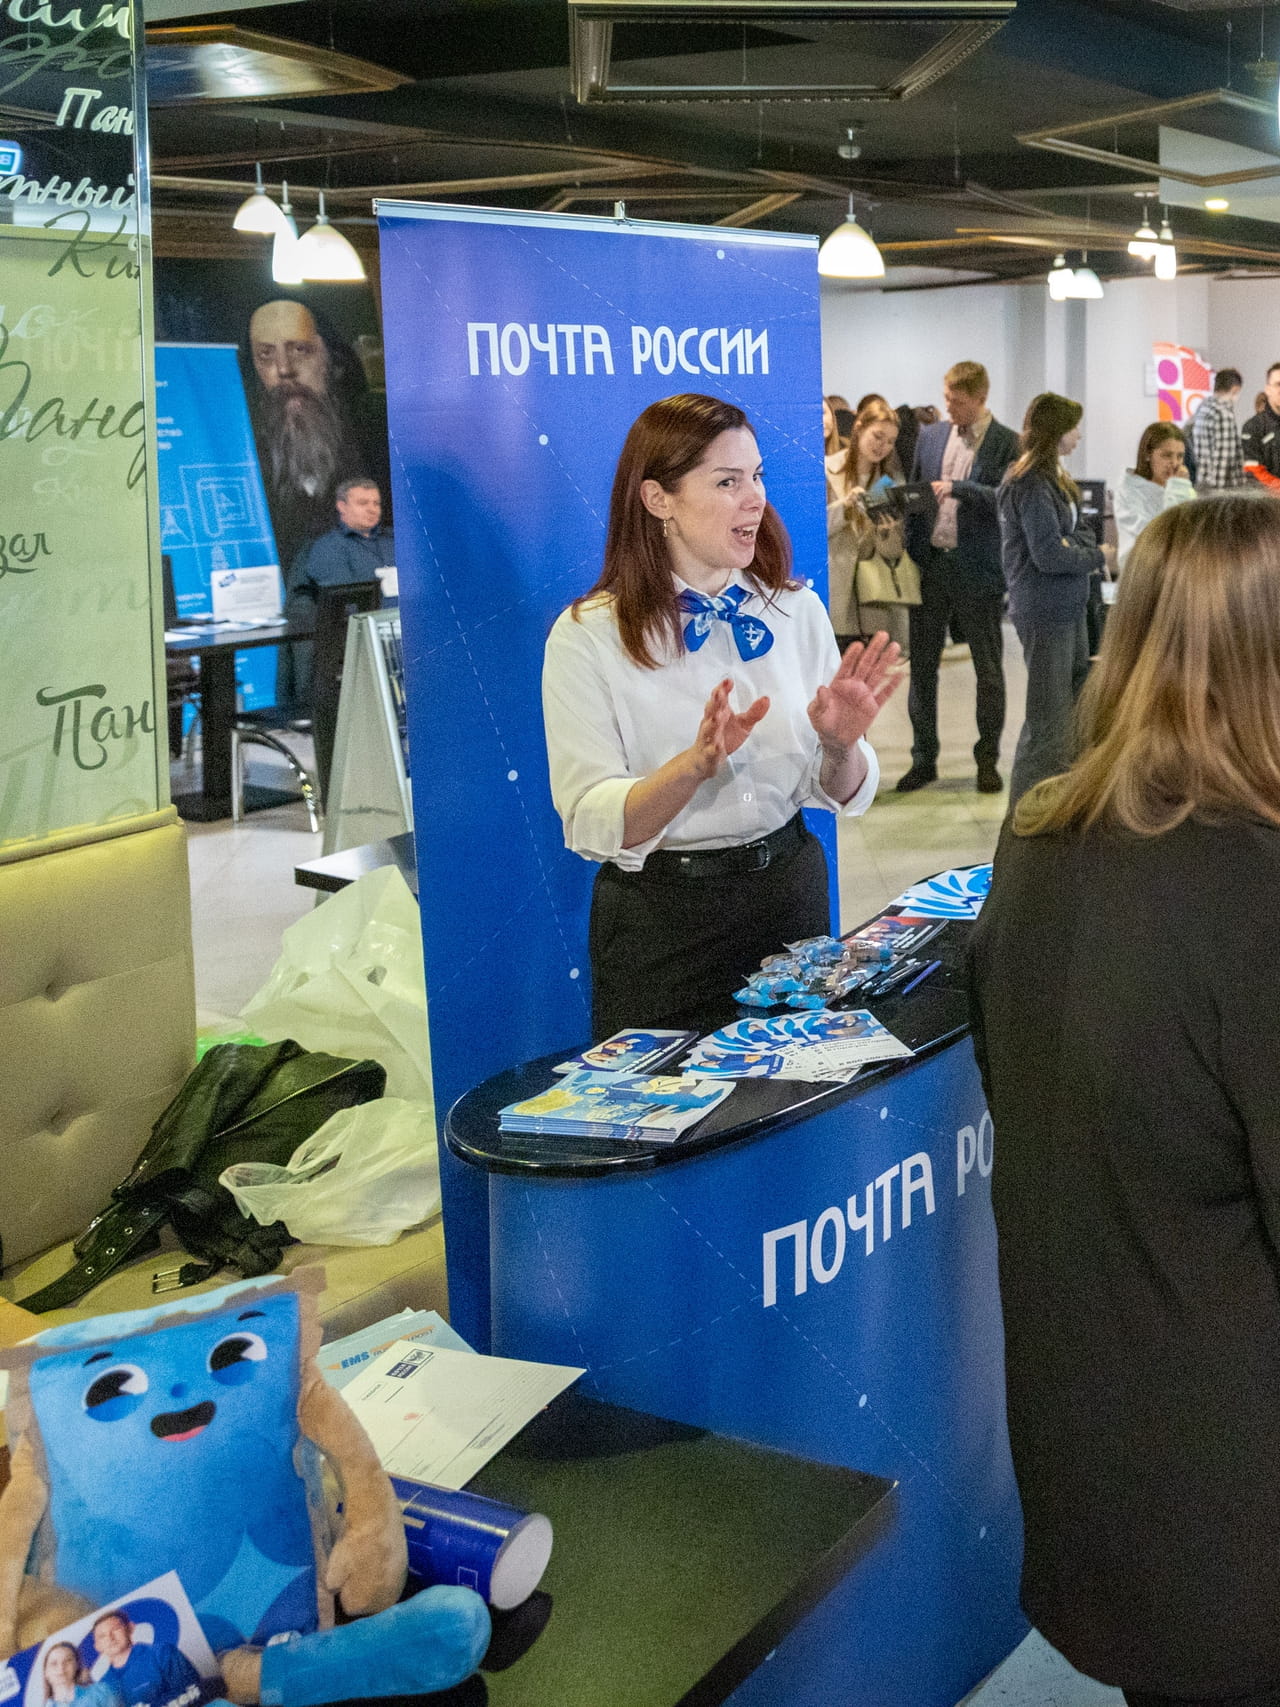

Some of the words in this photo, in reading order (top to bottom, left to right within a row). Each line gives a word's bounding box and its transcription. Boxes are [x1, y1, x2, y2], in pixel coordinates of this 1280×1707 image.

[467, 322, 615, 376] ПОЧТА
[631, 325, 769, 376] РОССИИ
[763, 1152, 936, 1308] ПОЧТА
[341, 1351, 370, 1369] EMS
